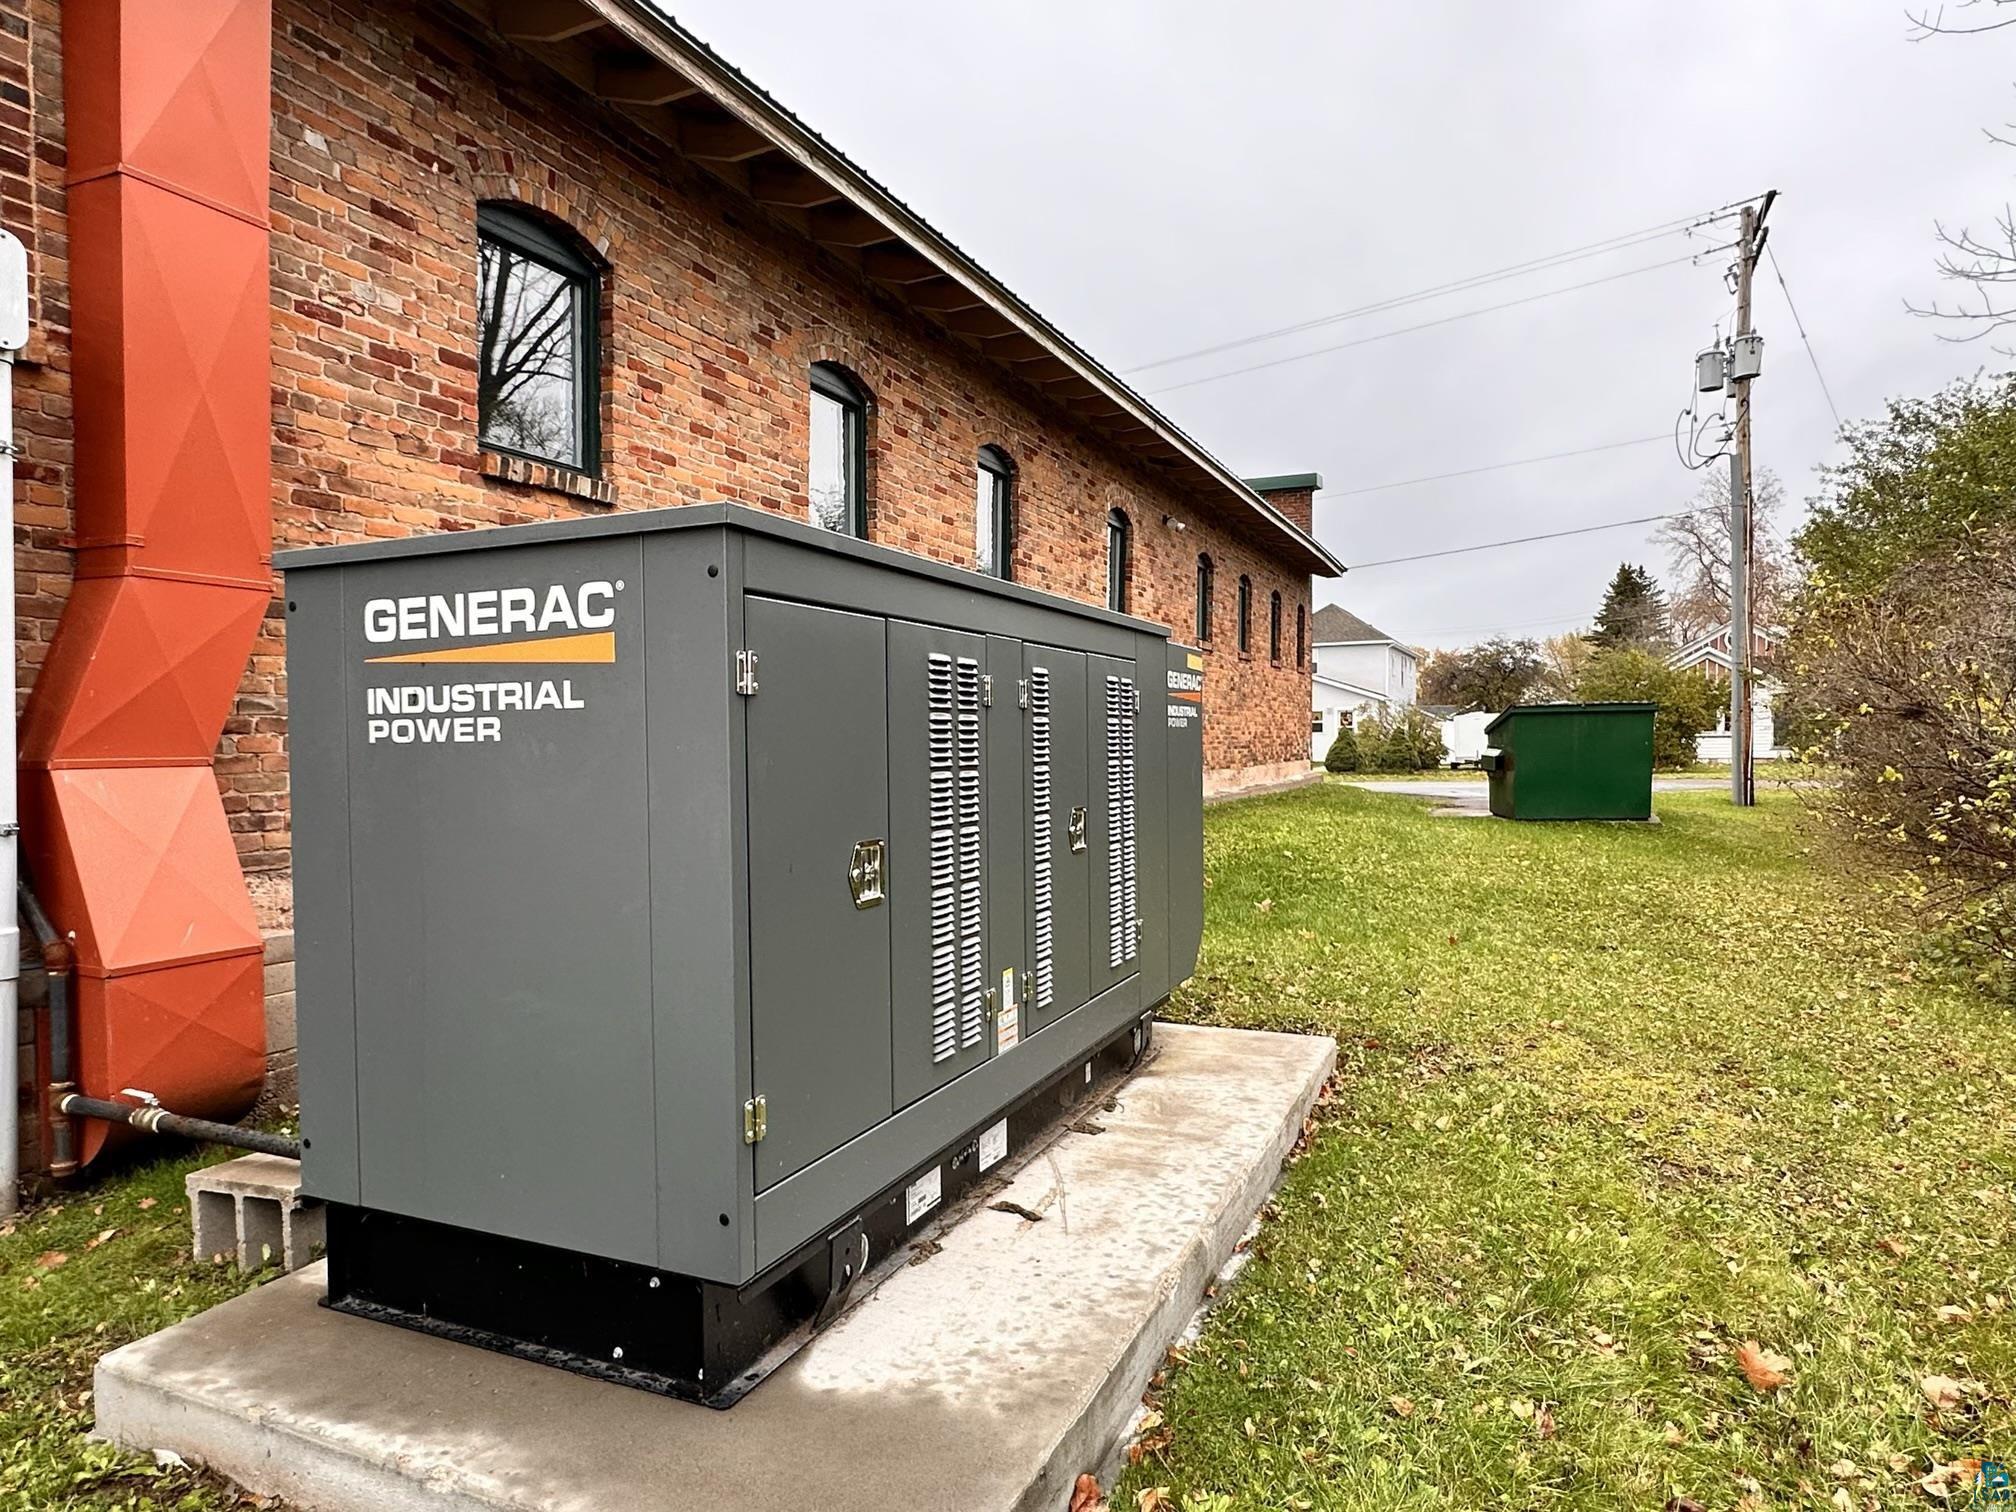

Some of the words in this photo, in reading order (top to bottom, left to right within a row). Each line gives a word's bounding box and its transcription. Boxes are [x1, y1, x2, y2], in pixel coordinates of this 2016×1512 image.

[364, 580, 615, 643] GENERAC
[1167, 670, 1202, 692] GENERAC
[367, 679, 585, 715] INDUSTRIAL
[1167, 704, 1198, 718] INDUSTRIAL
[1167, 717, 1188, 728] POWER
[368, 716, 501, 744] POWER
